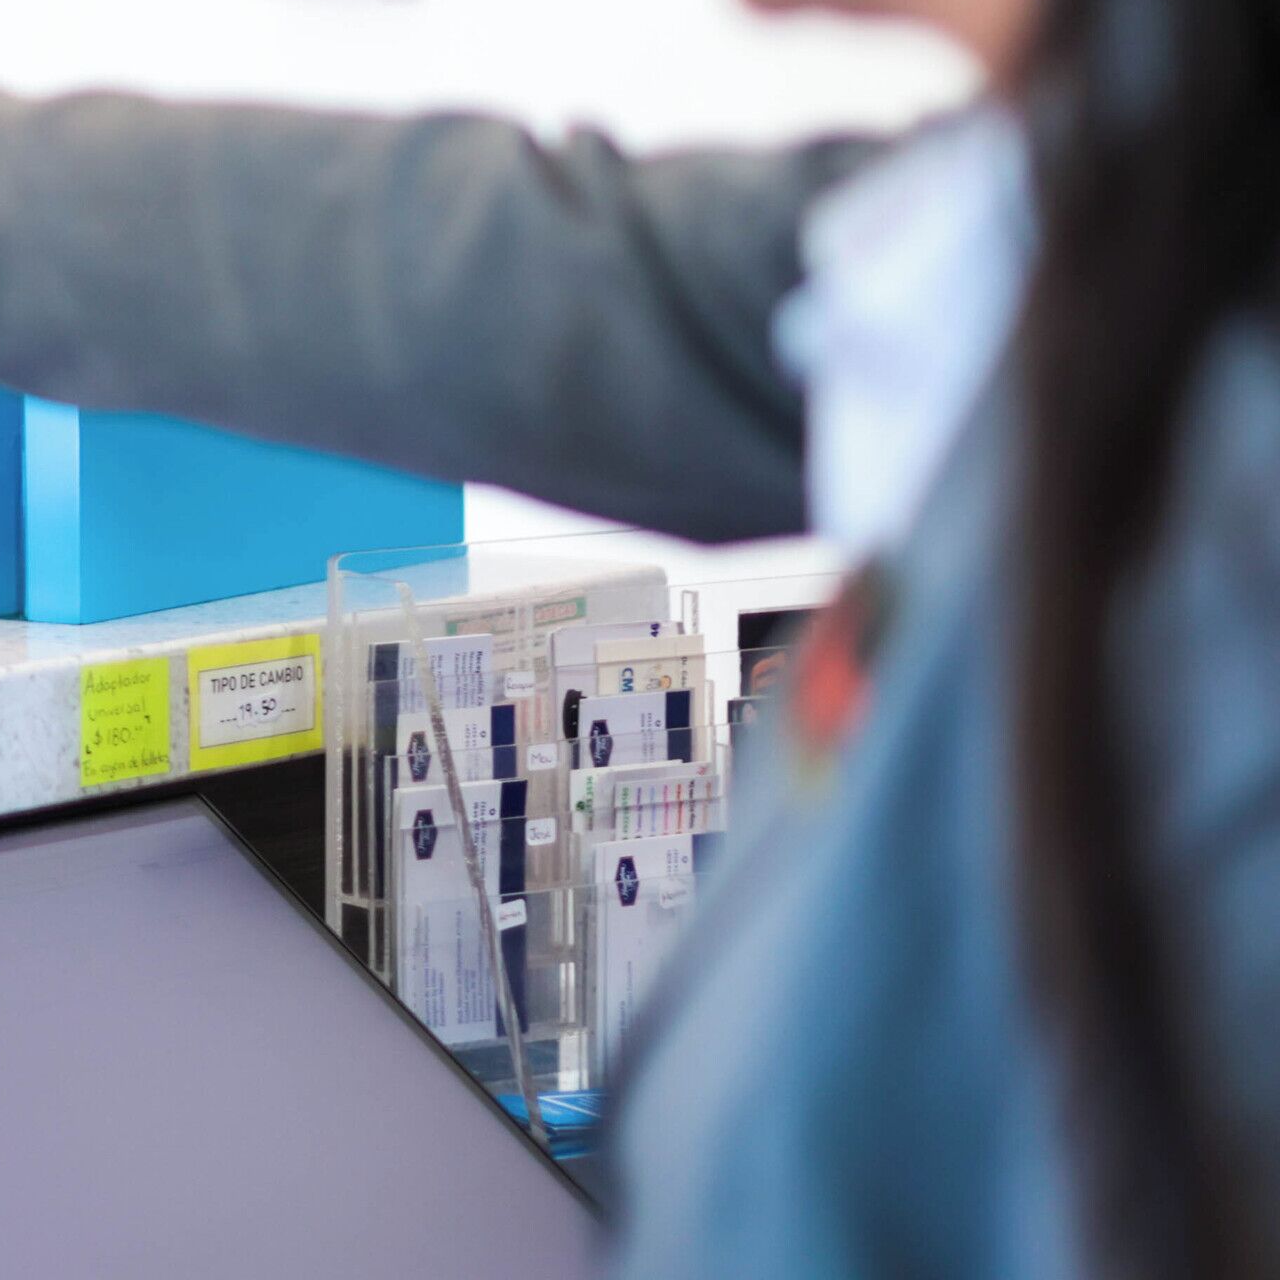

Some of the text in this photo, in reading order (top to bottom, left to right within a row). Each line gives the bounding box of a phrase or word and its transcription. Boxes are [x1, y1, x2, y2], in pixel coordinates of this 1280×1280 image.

[210, 665, 304, 694] TIPO DE CAMBIO
